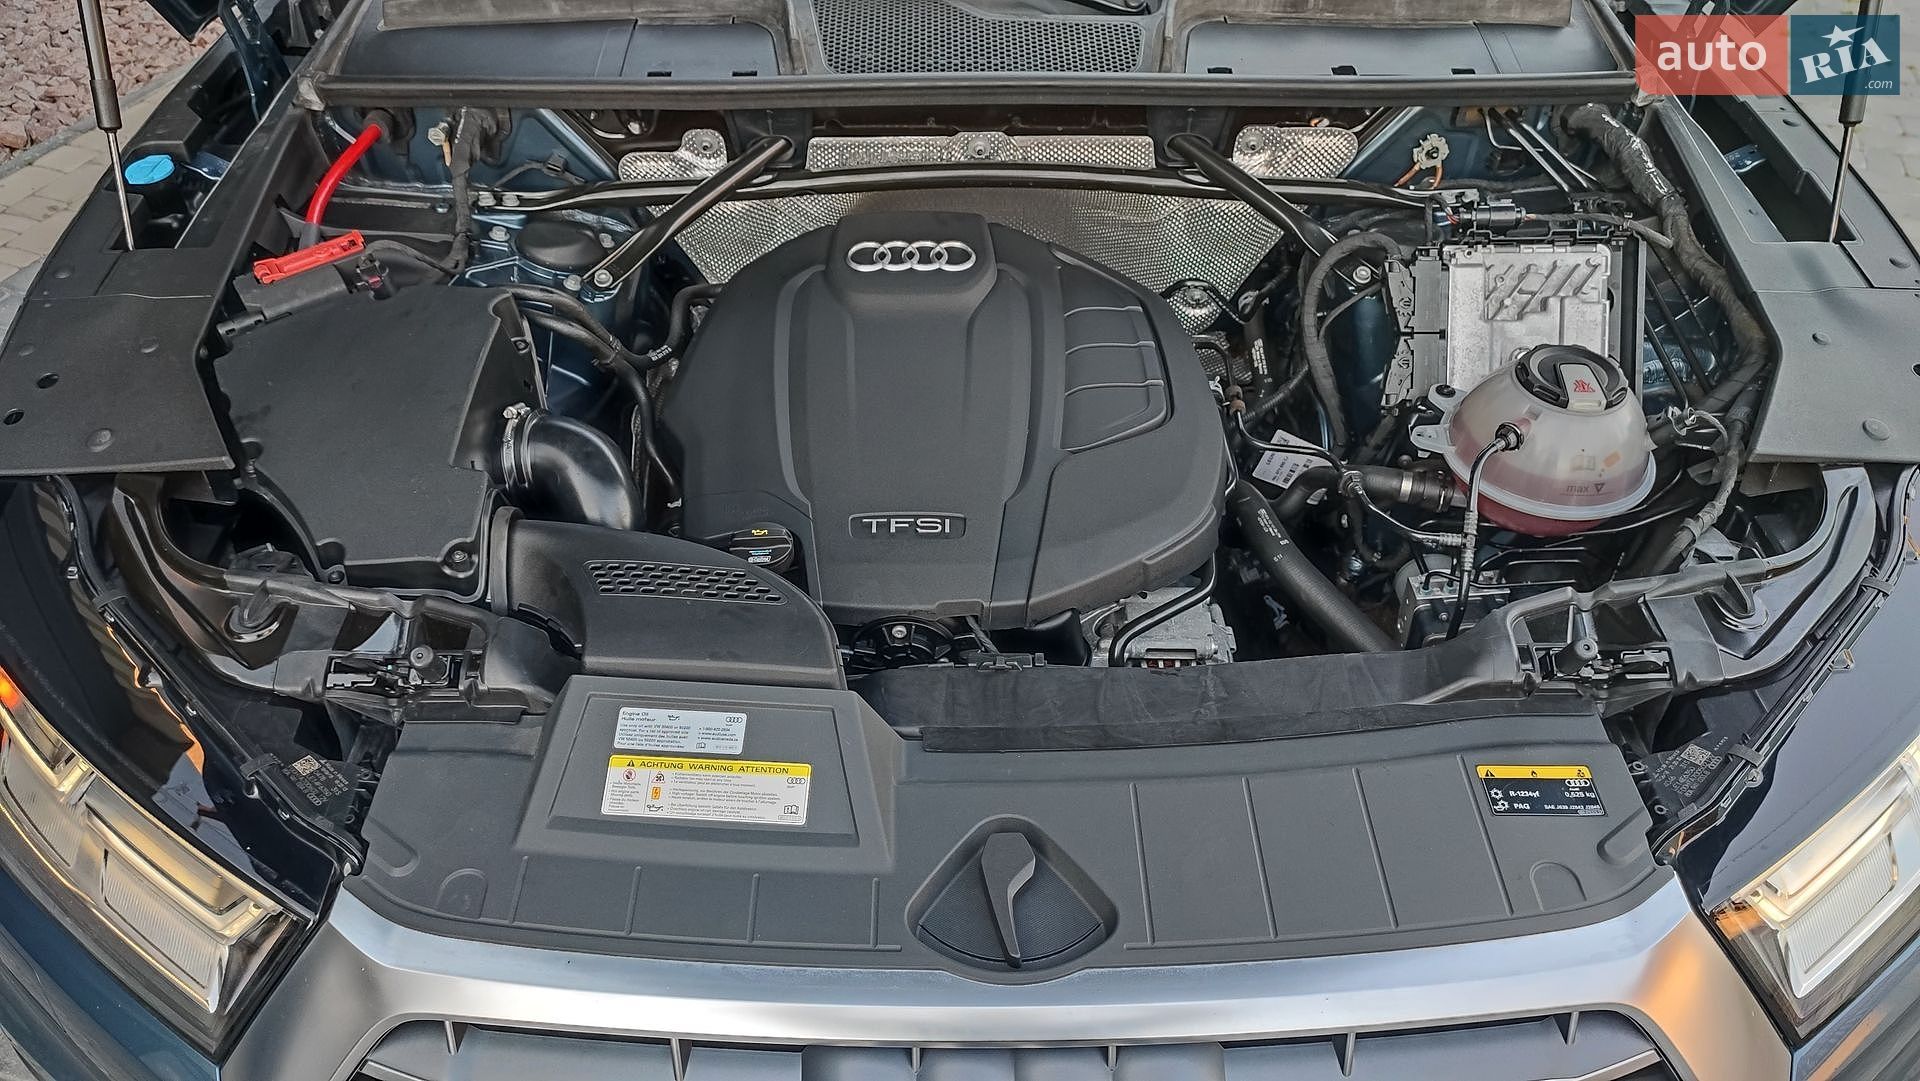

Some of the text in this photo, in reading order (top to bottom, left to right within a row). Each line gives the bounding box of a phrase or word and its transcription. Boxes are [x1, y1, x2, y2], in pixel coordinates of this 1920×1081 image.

[1567, 485, 1590, 493] max
[862, 518, 950, 534] TFSI
[639, 761, 789, 774] ACHTUNG WARNING ATTENTION
